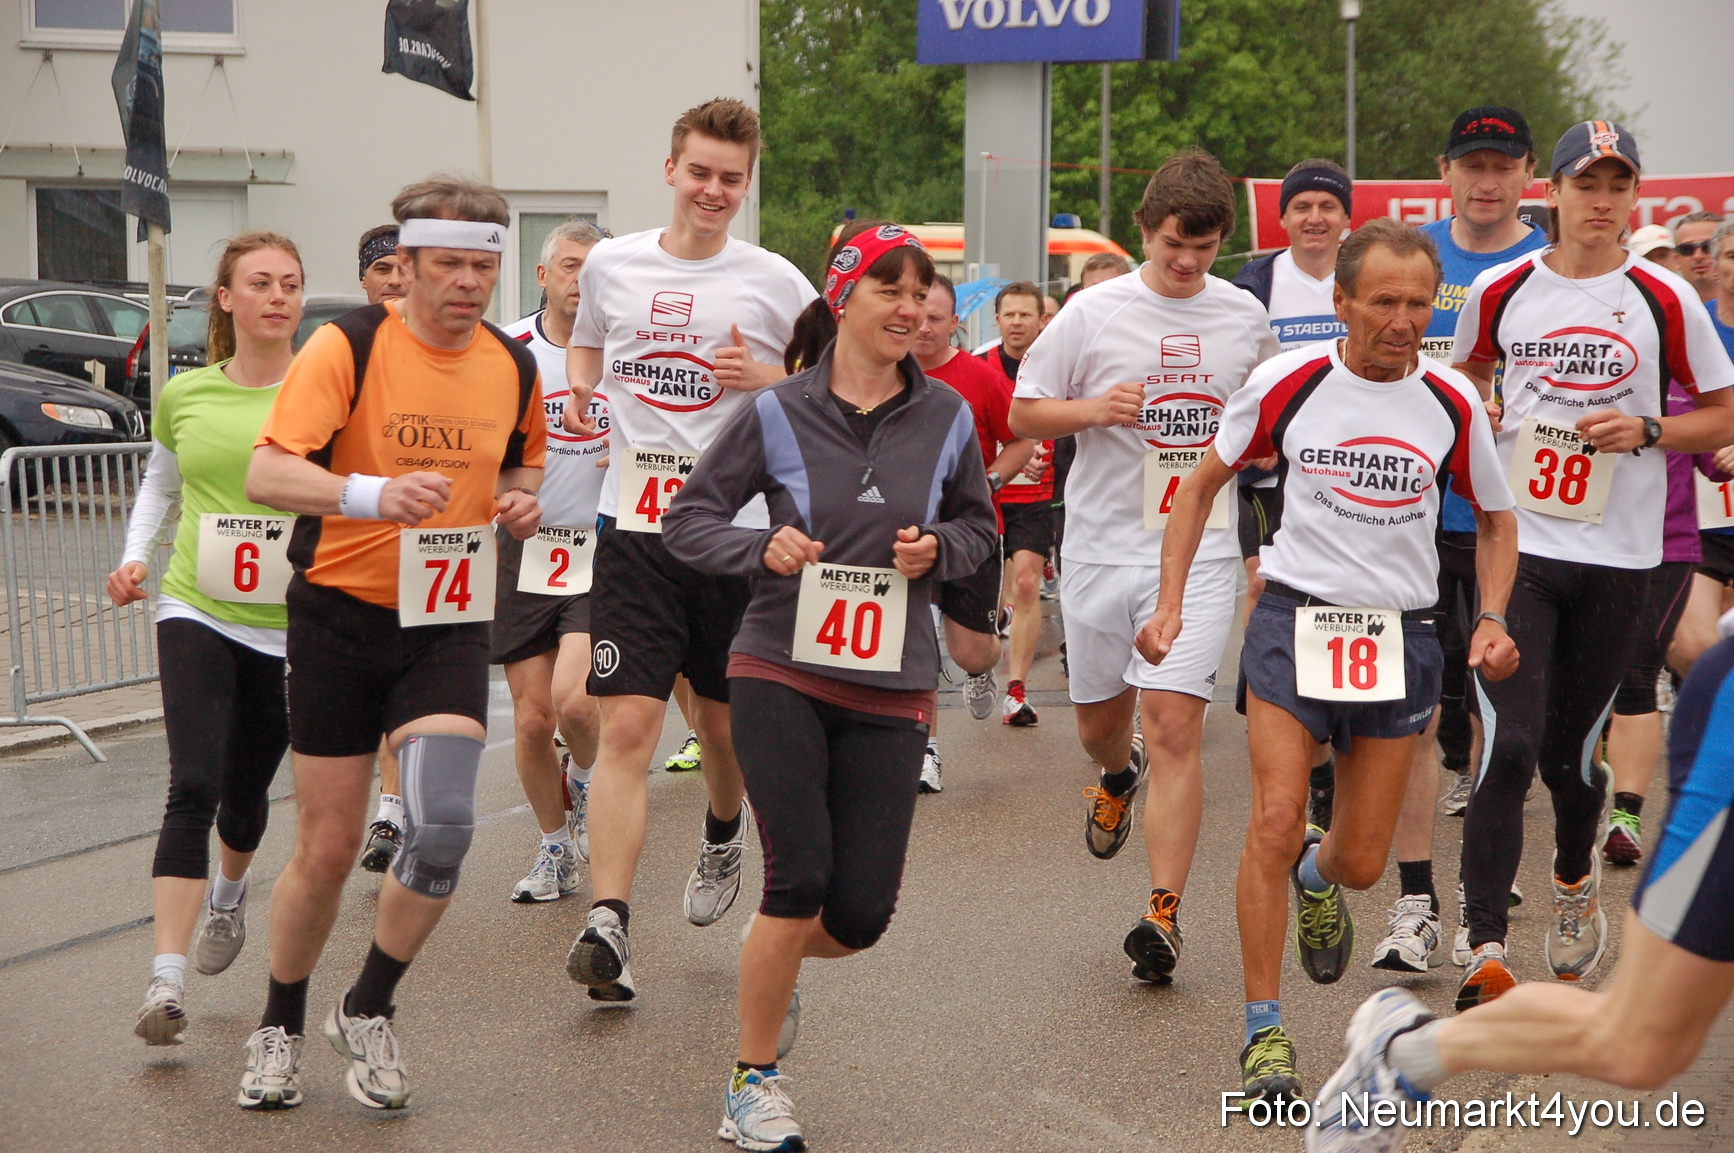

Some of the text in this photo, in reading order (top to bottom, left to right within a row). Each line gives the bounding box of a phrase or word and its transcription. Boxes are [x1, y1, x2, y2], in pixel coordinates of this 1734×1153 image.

[939, 0, 1111, 30] VOLVO
[636, 330, 703, 345] SEAT
[1419, 341, 1453, 351] MEYE
[1511, 342, 1613, 359] GERHART
[612, 359, 700, 384] GERHART
[1554, 359, 1624, 377] JÄNIG
[1147, 374, 1214, 384] SEAT
[648, 380, 712, 401] JÄNIG
[1587, 387, 1634, 407] Autohaus
[1160, 420, 1219, 437] JÄNIG
[1534, 424, 1579, 443] MEYER
[397, 425, 472, 451] OEXL
[1533, 434, 1579, 452] WERBUNG
[636, 452, 675, 464] MEYER
[1158, 452, 1197, 462] MEYER
[1299, 448, 1414, 474] GERHART
[636, 462, 676, 472] WERBUNG
[1301, 465, 1351, 477] Autohaus
[1528, 448, 1592, 506] 38
[857, 496, 885, 504] adidas
[1314, 490, 1333, 508] Das
[1334, 505, 1386, 526] sportliche
[216, 518, 263, 530] MEYER
[538, 526, 571, 537] MEYER
[216, 529, 263, 538] WERBUNG
[418, 533, 464, 546] MEYER
[537, 535, 571, 544] WERBUNG
[418, 544, 464, 554] WERBUNG
[233, 541, 260, 593] 6
[547, 547, 570, 588] 2
[821, 568, 870, 584] MEYER
[425, 558, 472, 613] 74
[820, 581, 870, 593] WERBUNG
[1314, 613, 1363, 624] MEYER
[816, 599, 882, 659] 40
[1314, 624, 1364, 633] WERBUNG
[597, 648, 612, 670] 90
[1327, 637, 1377, 690] 18
[1252, 1003, 1269, 1014] TECH
